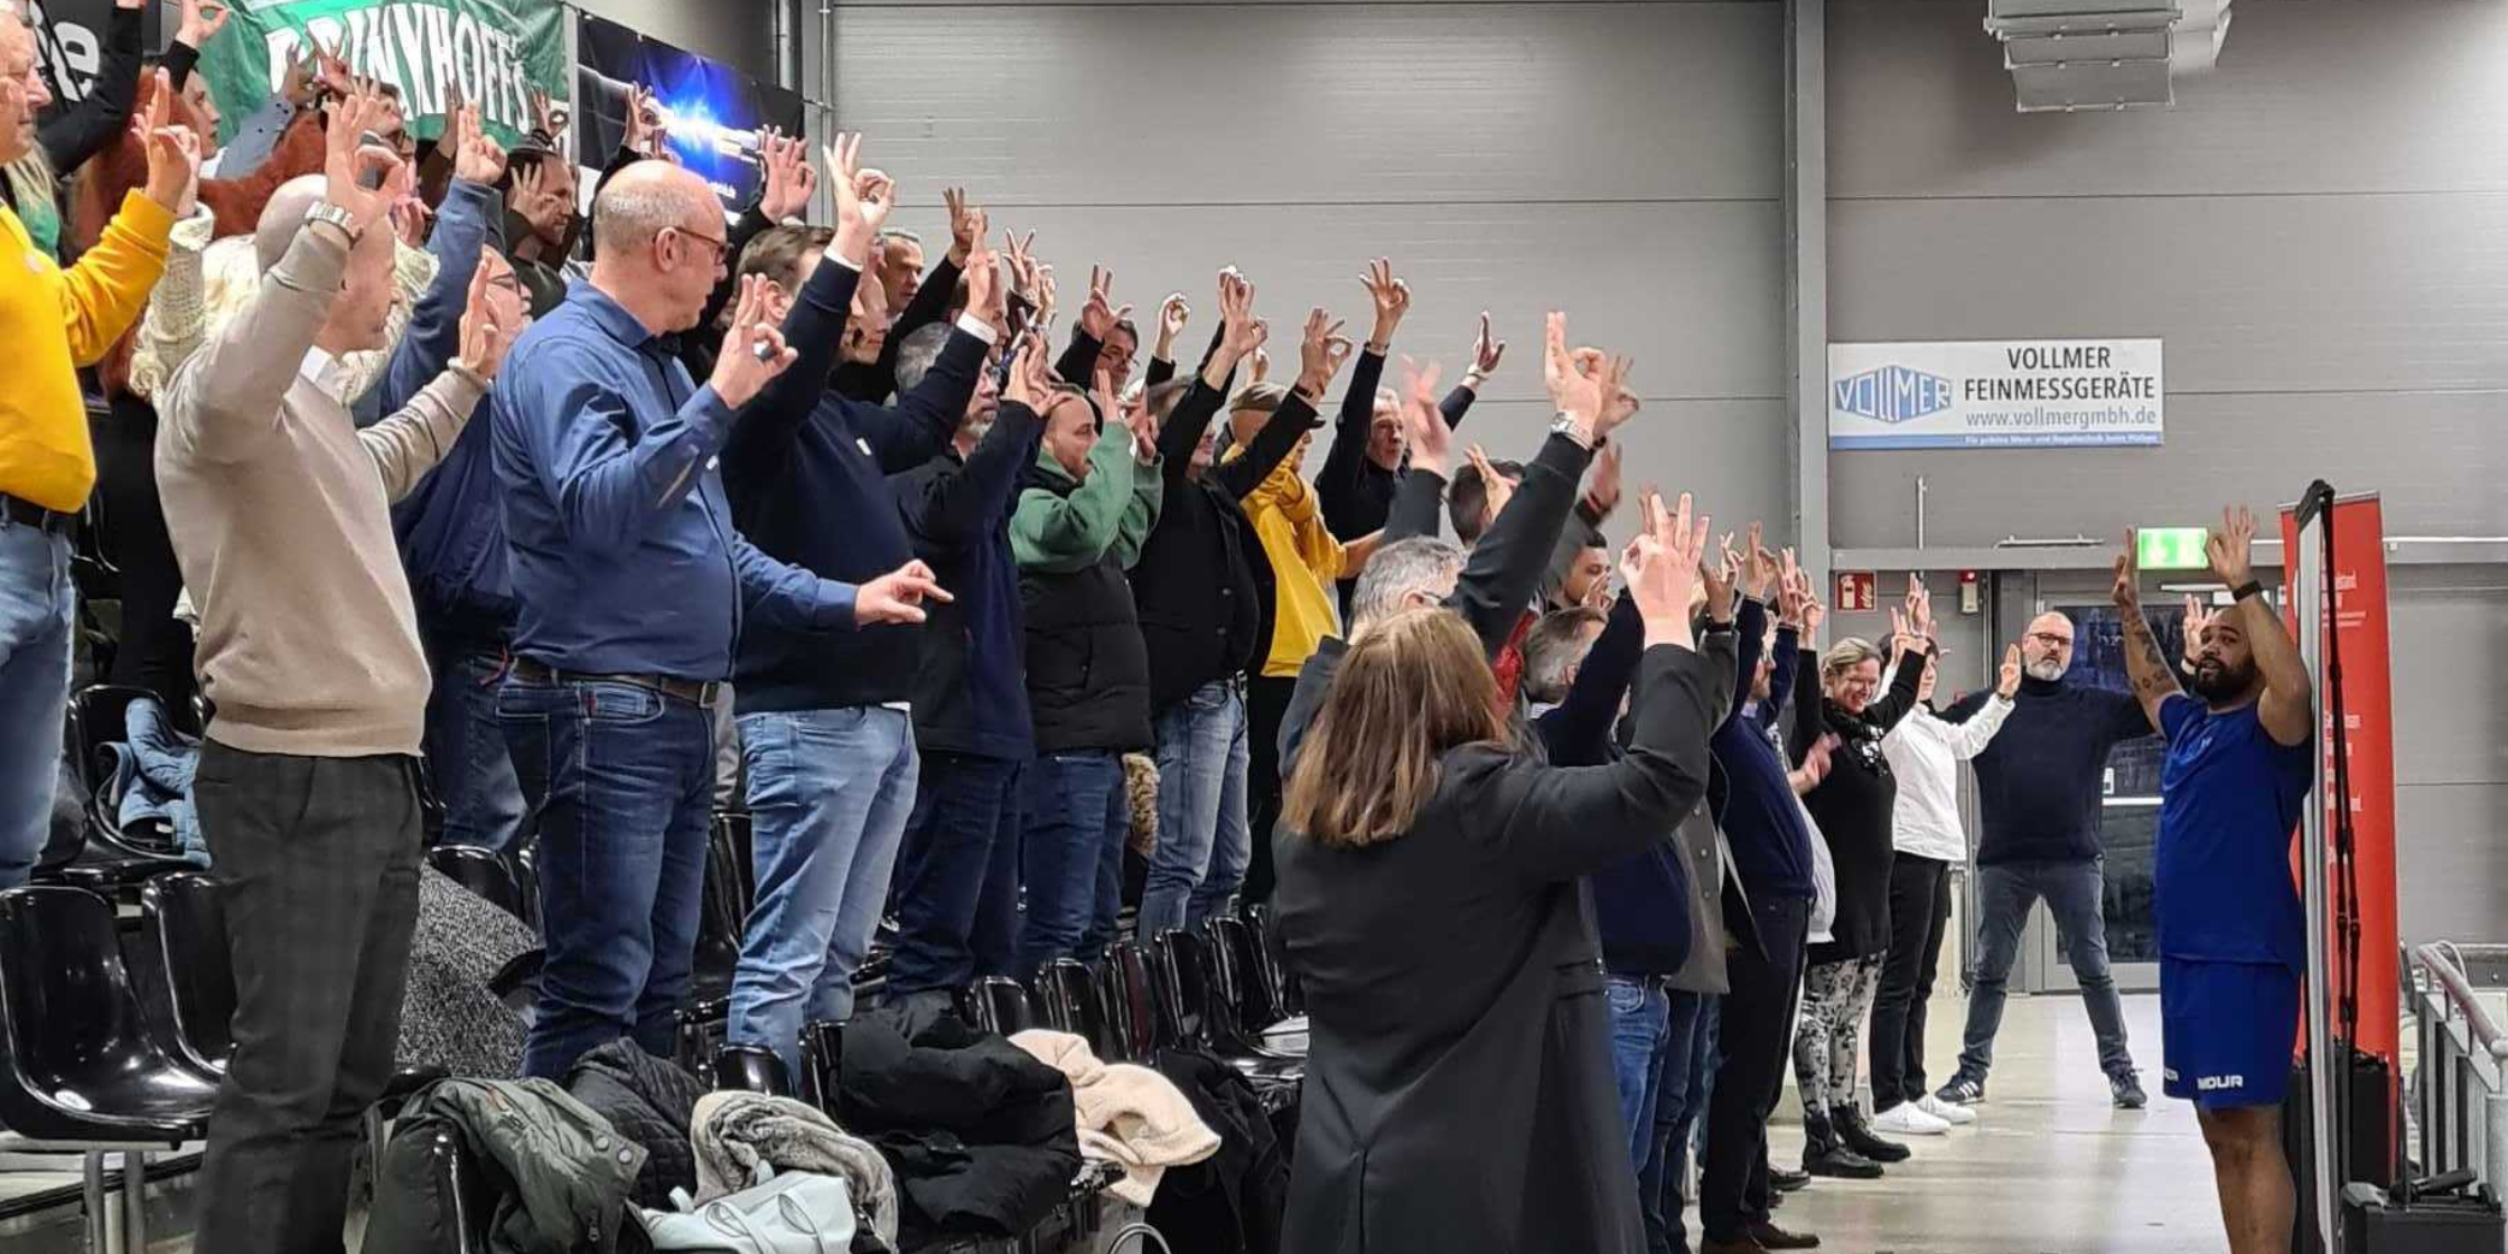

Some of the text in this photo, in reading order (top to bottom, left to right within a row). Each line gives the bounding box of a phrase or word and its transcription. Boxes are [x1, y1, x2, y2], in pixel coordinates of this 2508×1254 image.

[2006, 347, 2112, 370] VOLLMER
[1837, 366, 1951, 421] VOLLMER
[1964, 371, 2156, 401] FEINMESSGERÄTE
[1966, 405, 2157, 430] www.vollmergmbh.de
